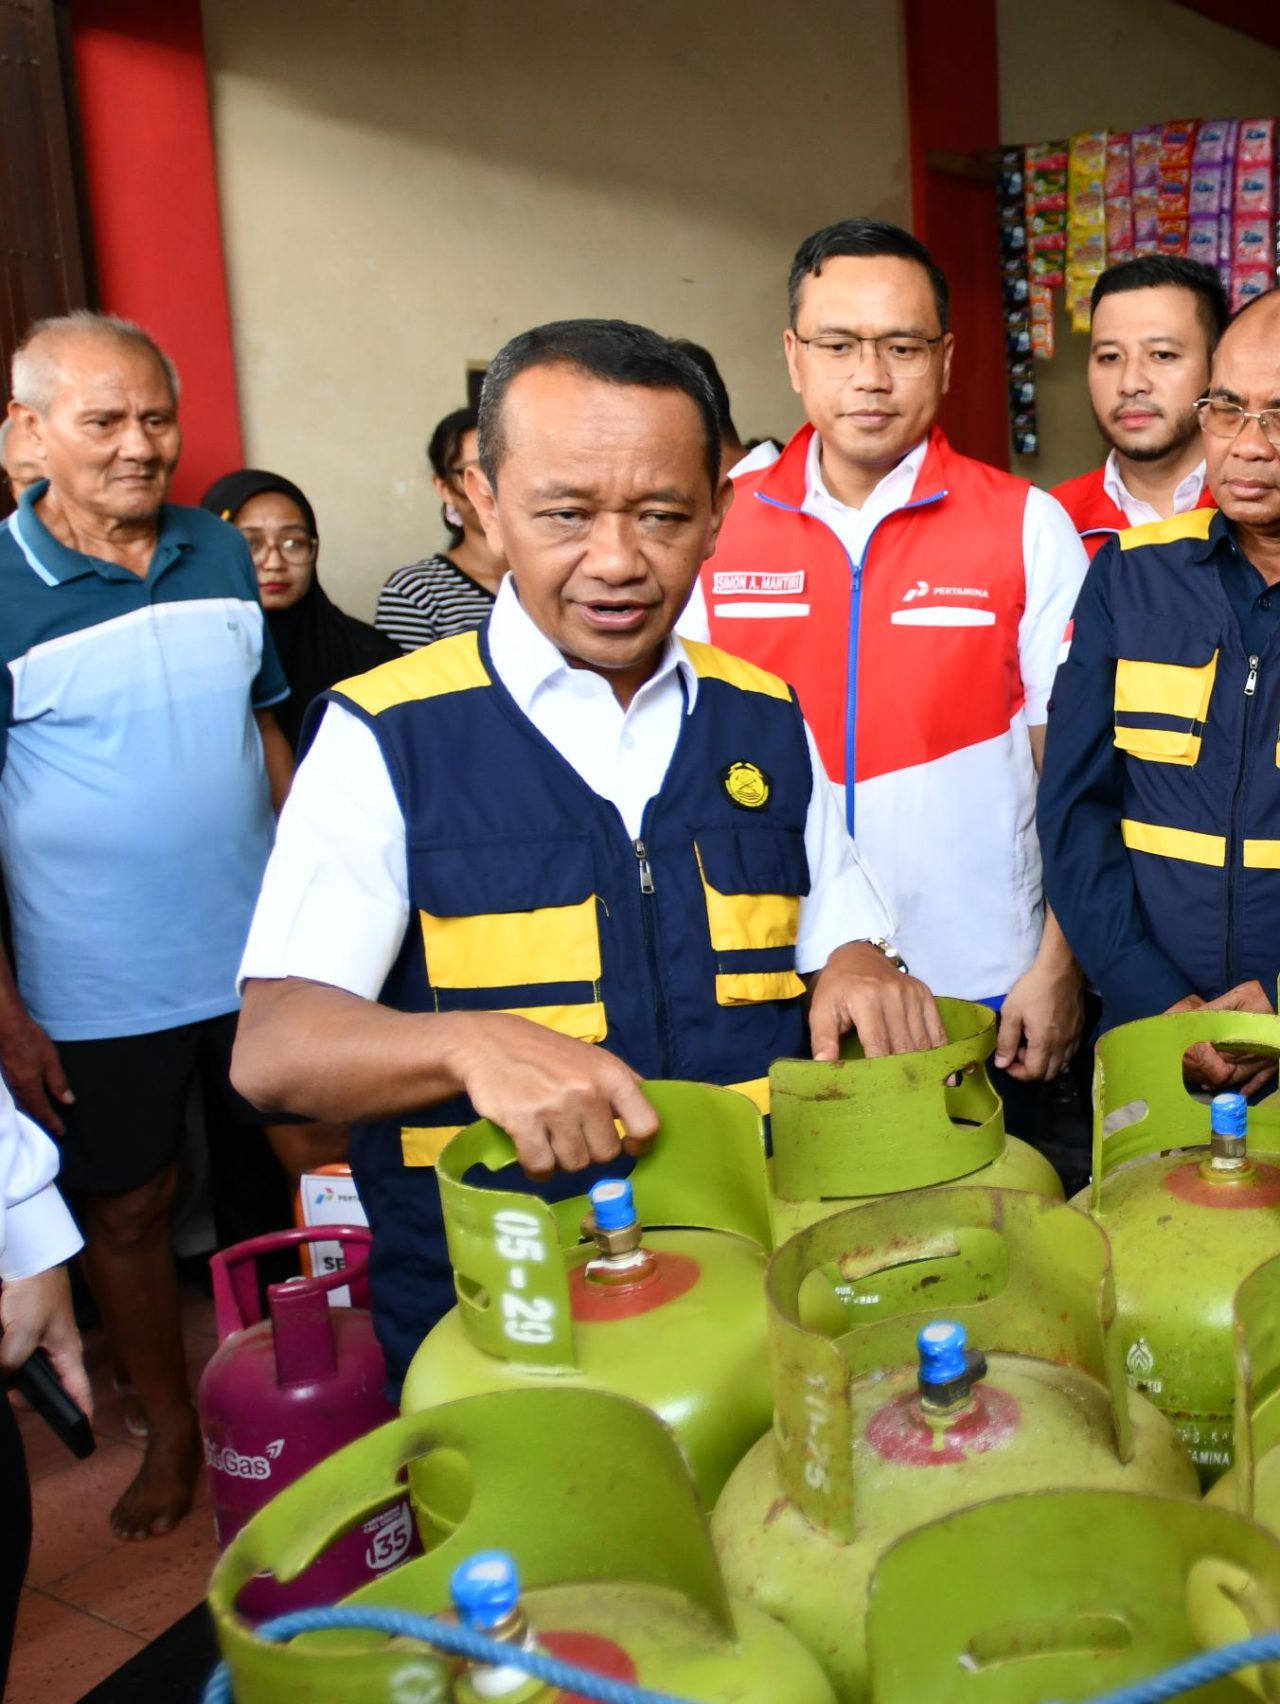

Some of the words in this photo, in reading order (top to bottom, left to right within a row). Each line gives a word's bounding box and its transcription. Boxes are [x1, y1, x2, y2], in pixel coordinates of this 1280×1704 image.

[717, 575, 746, 590] SIMON
[933, 586, 989, 599] PERTAMINA
[493, 1208, 556, 1344] 05-29
[1187, 1449, 1230, 1466] AMINA
[370, 1524, 408, 1565] 135
